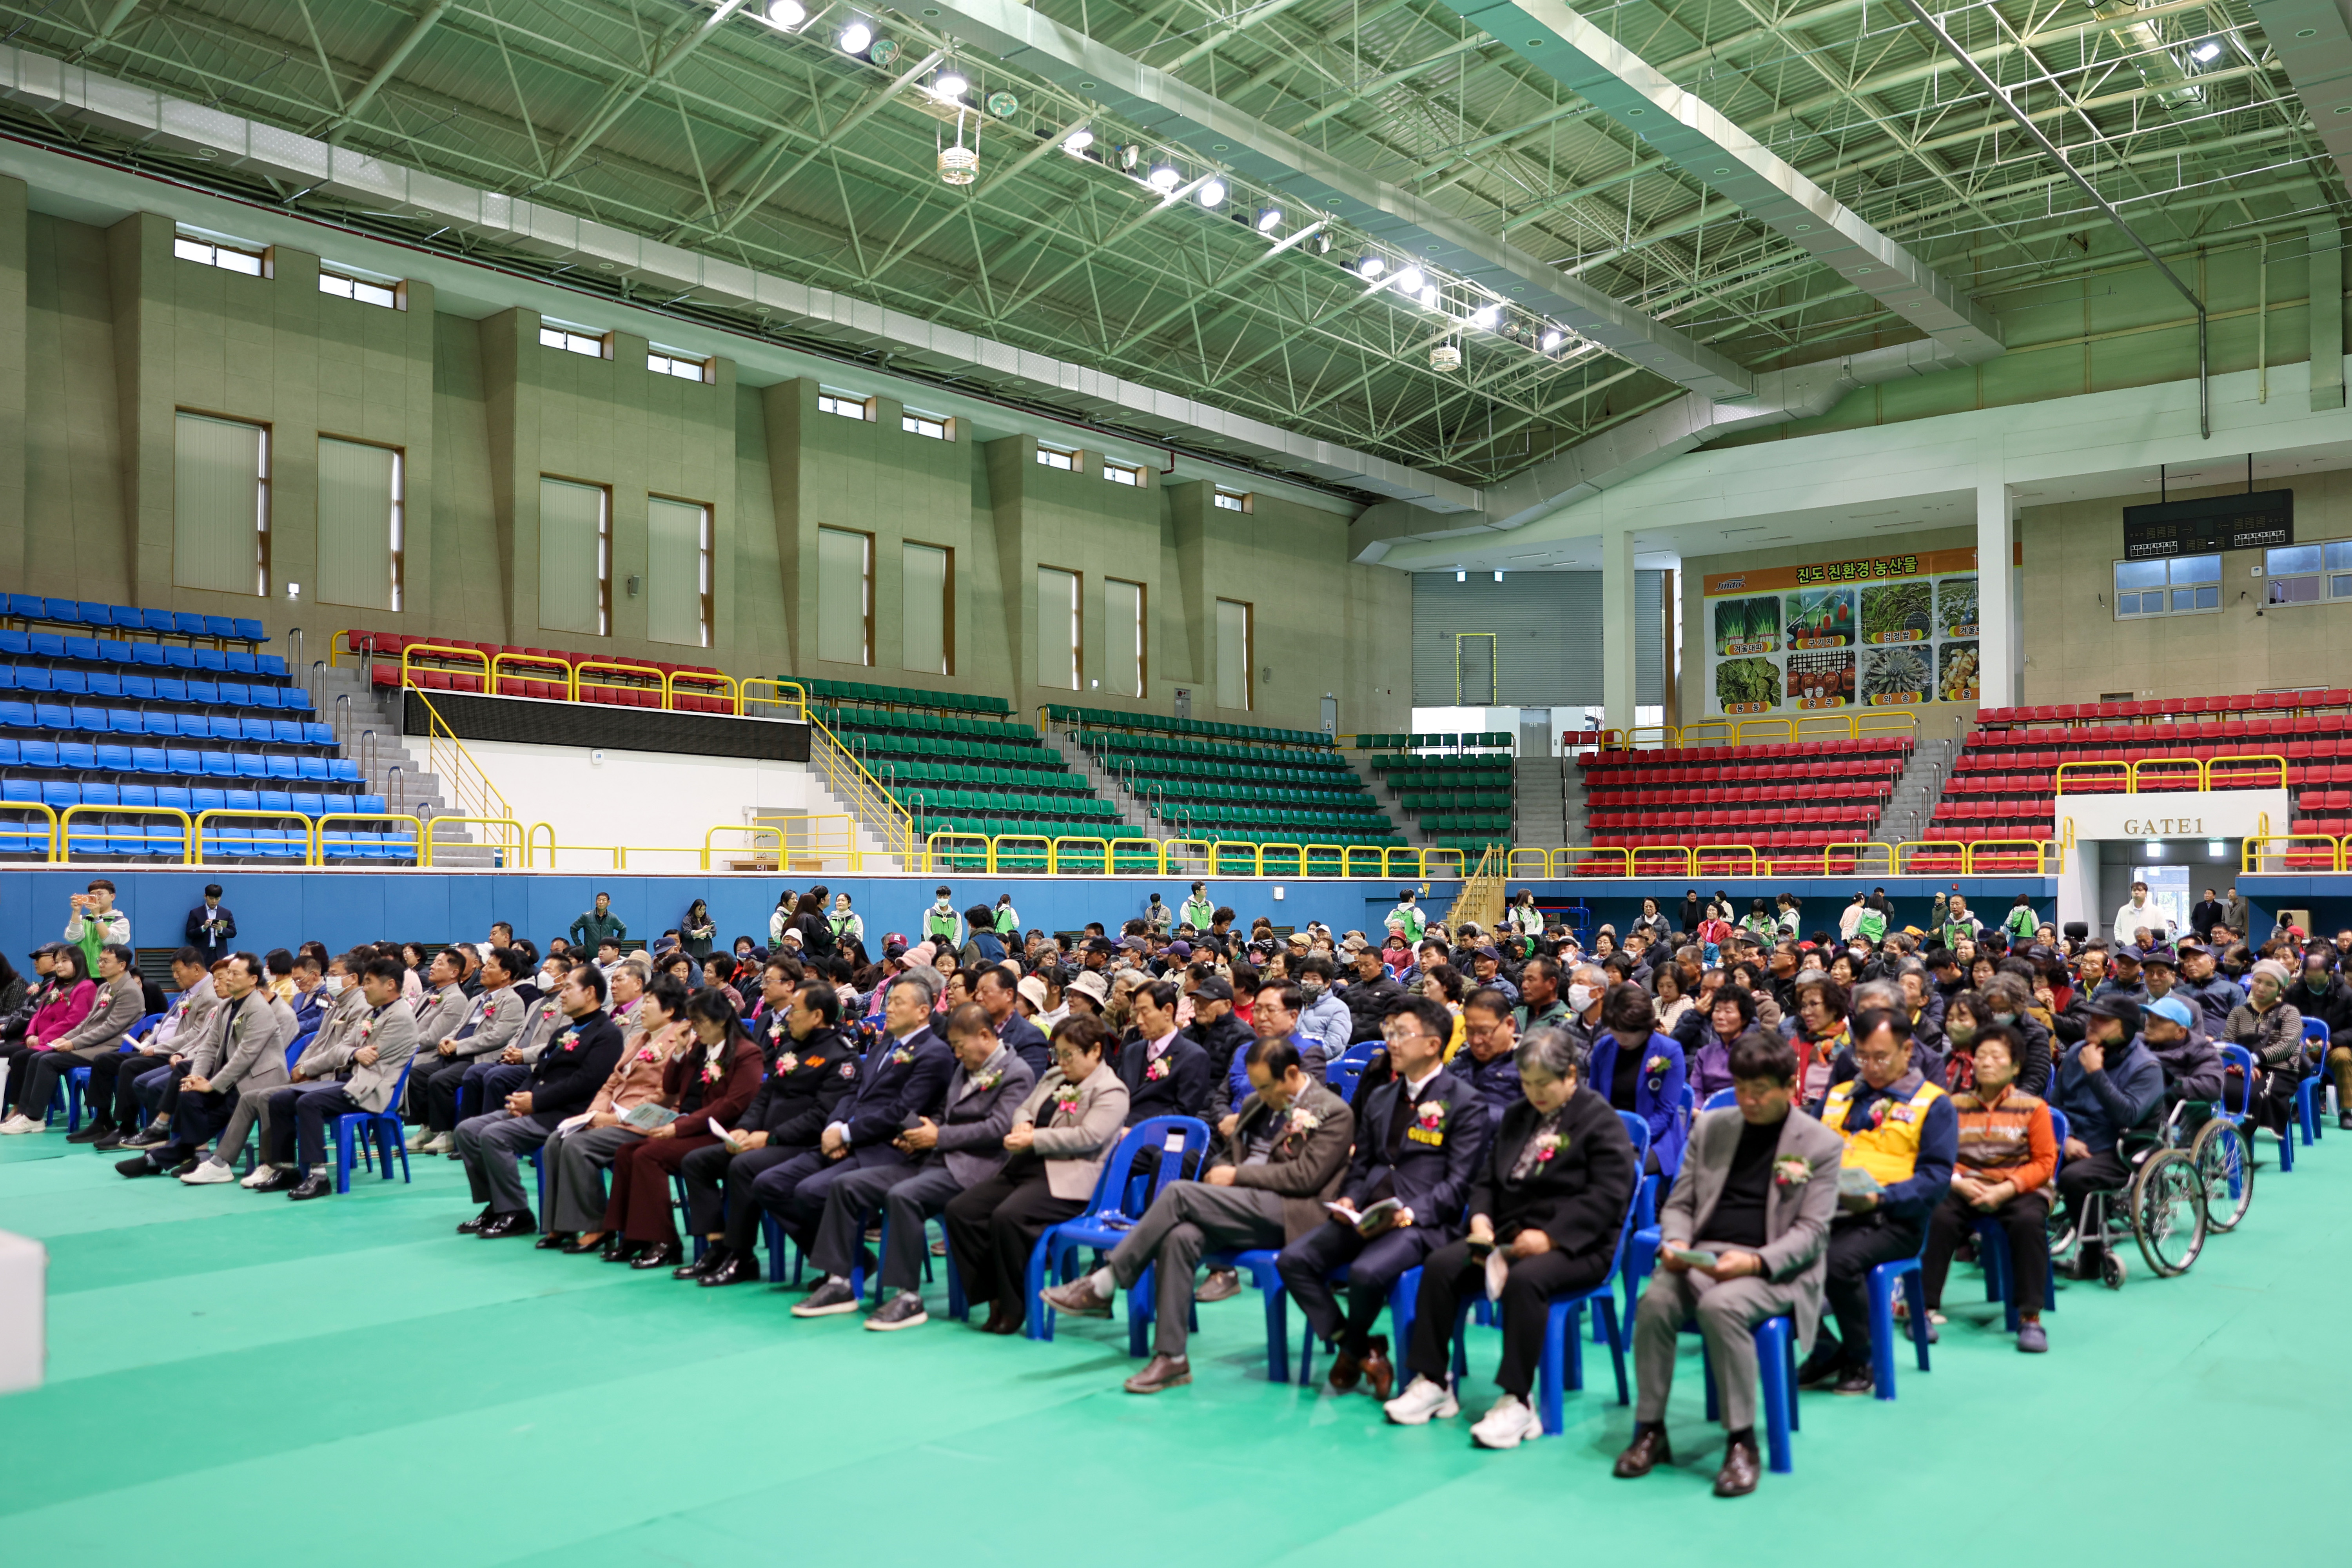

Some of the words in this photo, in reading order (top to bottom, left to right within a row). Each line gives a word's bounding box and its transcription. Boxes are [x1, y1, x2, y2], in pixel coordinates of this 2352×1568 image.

[1797, 567, 1825, 584] 진도
[1828, 561, 1869, 581] 친환경
[1873, 555, 1918, 576] 농산물
[1715, 581, 1742, 591] Jindo
[1884, 631, 1910, 642] 검정쌀
[1734, 643, 1763, 654] 겨울대파
[1808, 638, 1835, 648] 구기자
[2124, 818, 2203, 834] GATE1
